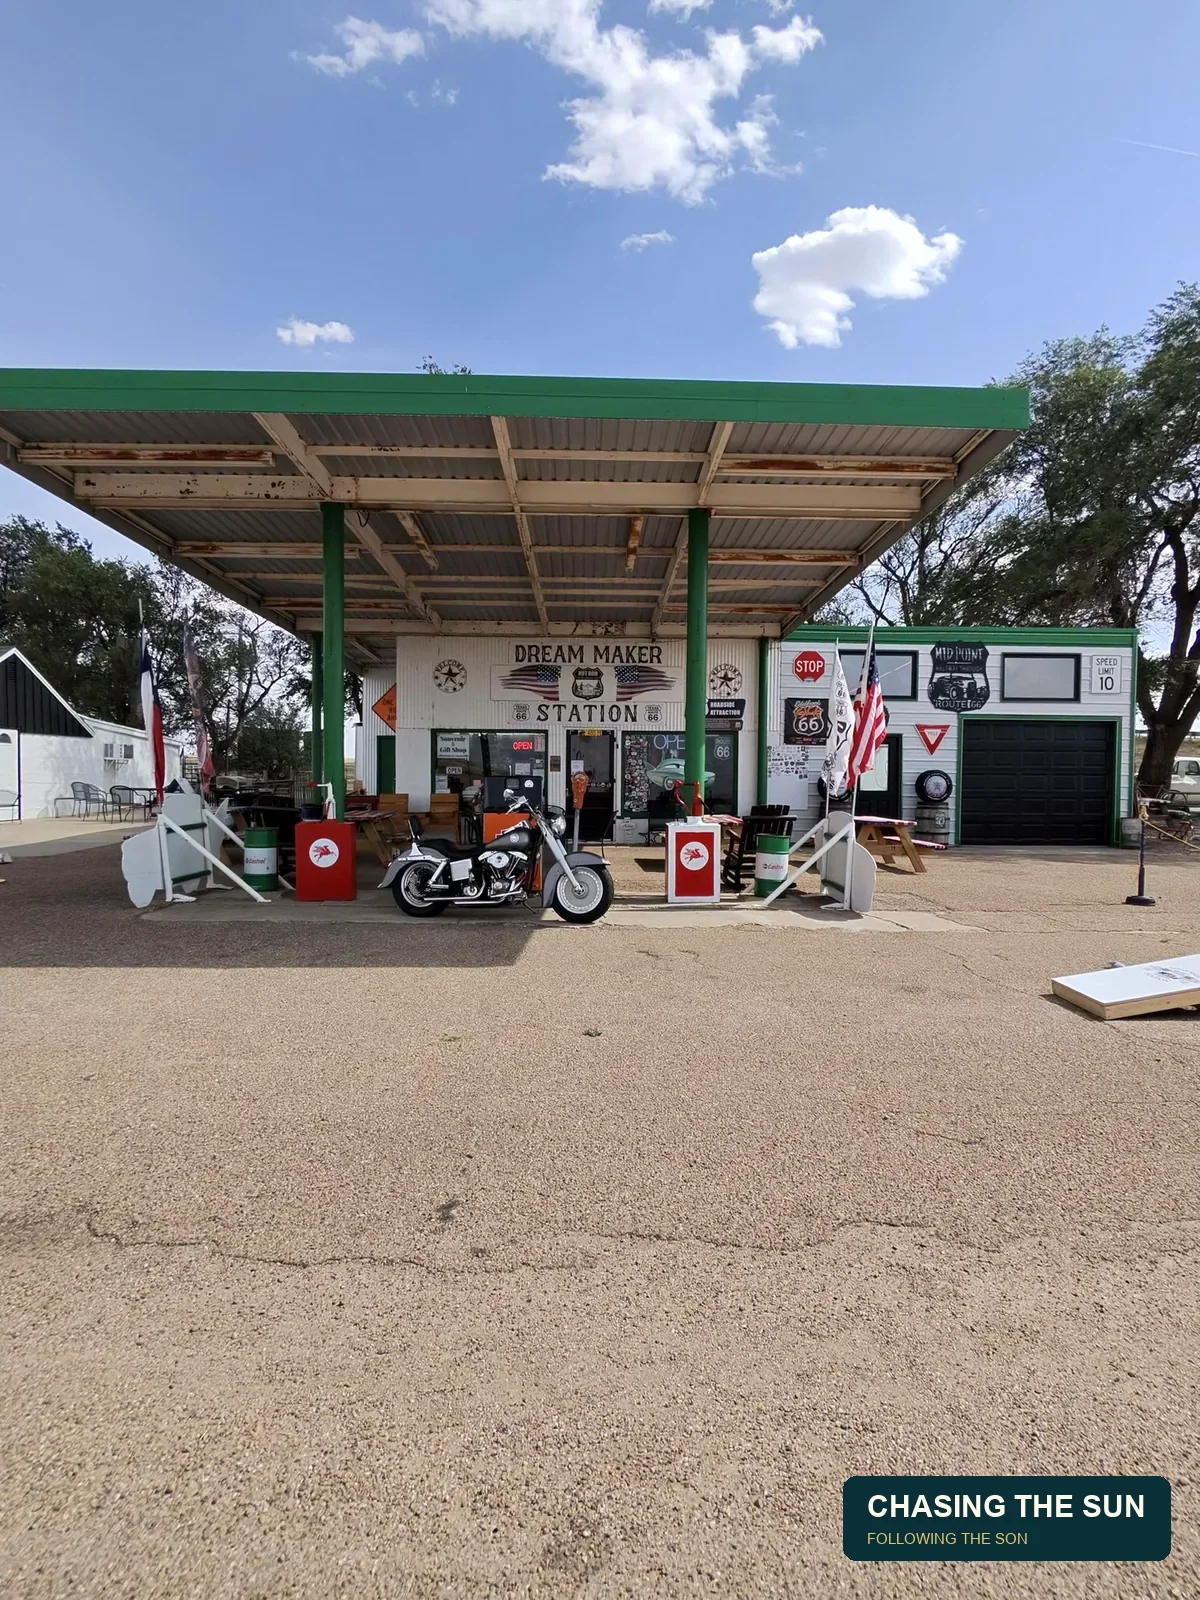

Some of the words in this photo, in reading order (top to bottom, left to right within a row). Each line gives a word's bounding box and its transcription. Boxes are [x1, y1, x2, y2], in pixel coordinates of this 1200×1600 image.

[515, 644, 584, 664] DREAM
[593, 645, 662, 664] MAKER
[935, 647, 954, 661] MID
[955, 646, 983, 662] POINT
[434, 660, 466, 673] WELCOME
[796, 660, 824, 673] STOP
[1096, 657, 1118, 666] SPEED
[711, 664, 741, 677] WELCOME
[1097, 667, 1115, 675] LIMIT
[1099, 676, 1115, 691] 10
[516, 712, 527, 721] 66
[536, 703, 638, 723] STATION
[647, 713, 659, 722] 66
[799, 716, 819, 732] 66
[512, 741, 533, 750] OPEN
[653, 733, 687, 750] OPE
[451, 746, 467, 754] Shop
[716, 745, 731, 758] 66
